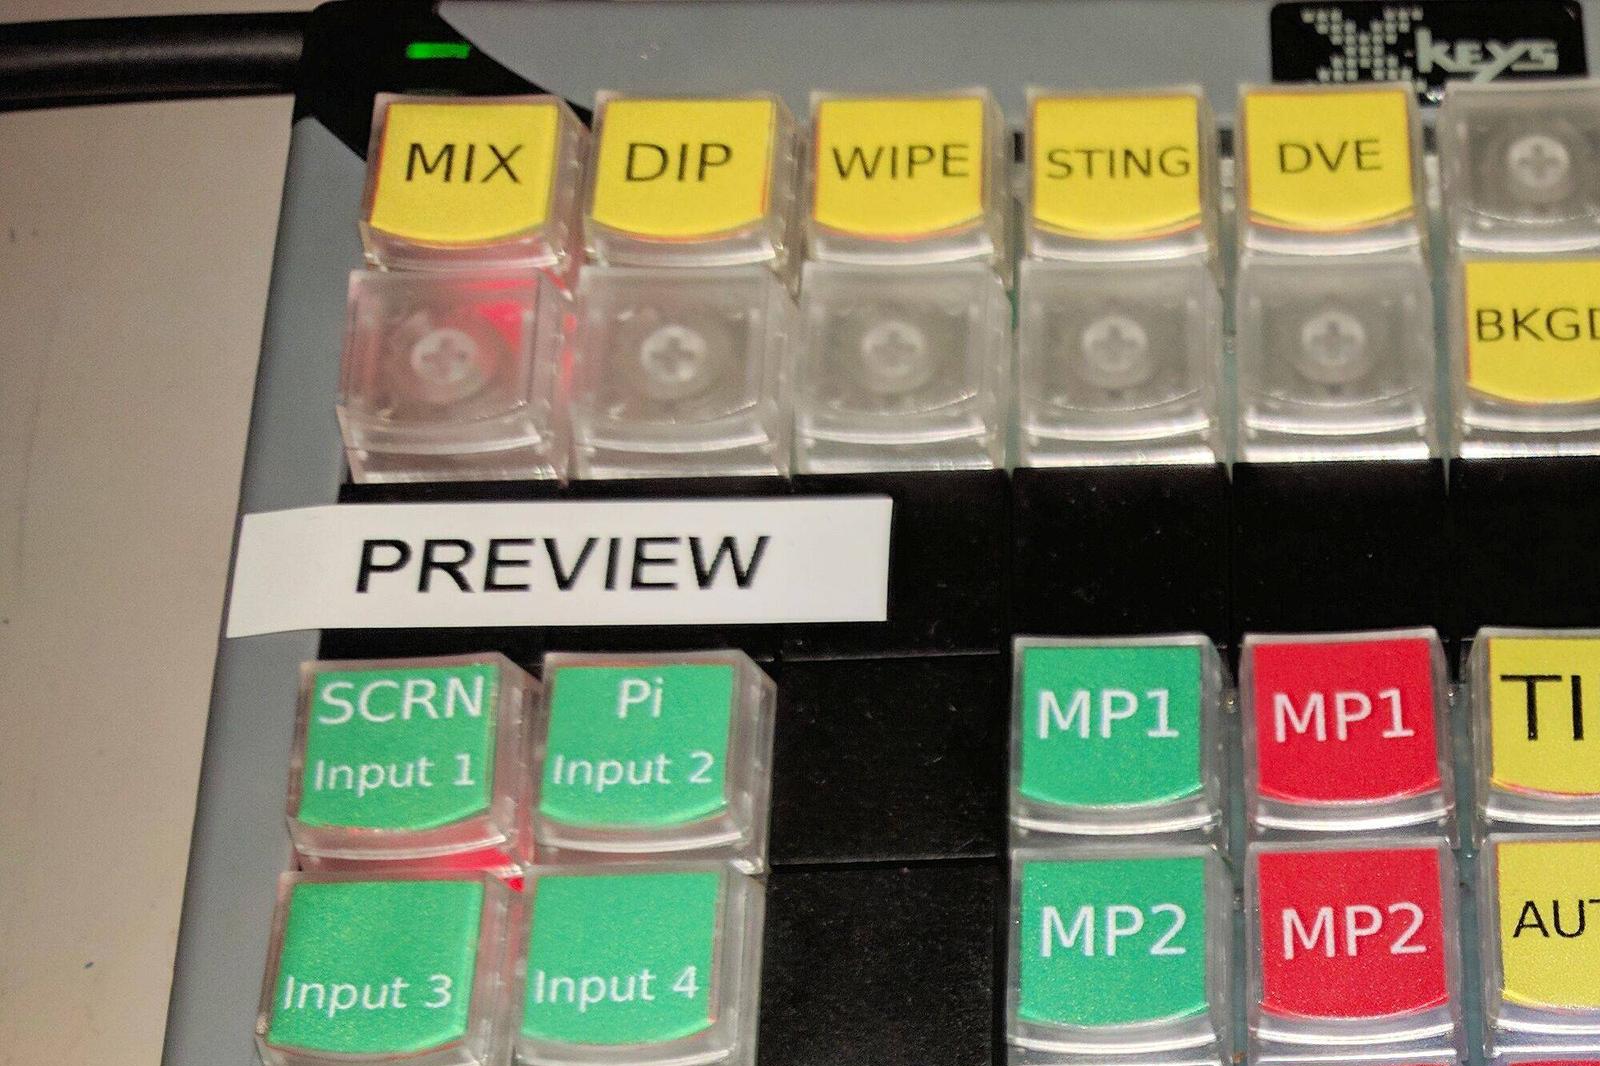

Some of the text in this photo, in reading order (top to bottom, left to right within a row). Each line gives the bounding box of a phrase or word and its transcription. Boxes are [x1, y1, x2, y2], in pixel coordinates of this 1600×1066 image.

[403, 141, 524, 186] MIX
[623, 140, 734, 184] DIP
[830, 141, 971, 181] WIPE
[1045, 144, 1191, 181] STING
[1276, 138, 1383, 176] DVE
[354, 534, 771, 595] PREVIEW
[318, 675, 486, 726] SCRN
[615, 678, 665, 719] Pi
[1035, 688, 1180, 740] MP1
[1272, 688, 1415, 743] MP1
[312, 752, 476, 798] Input 1
[551, 750, 715, 794] Input 2
[1039, 904, 1187, 958] MP2
[1281, 902, 1427, 960] MP2
[282, 974, 452, 1016] Input 3
[534, 965, 699, 1009] Input 4
